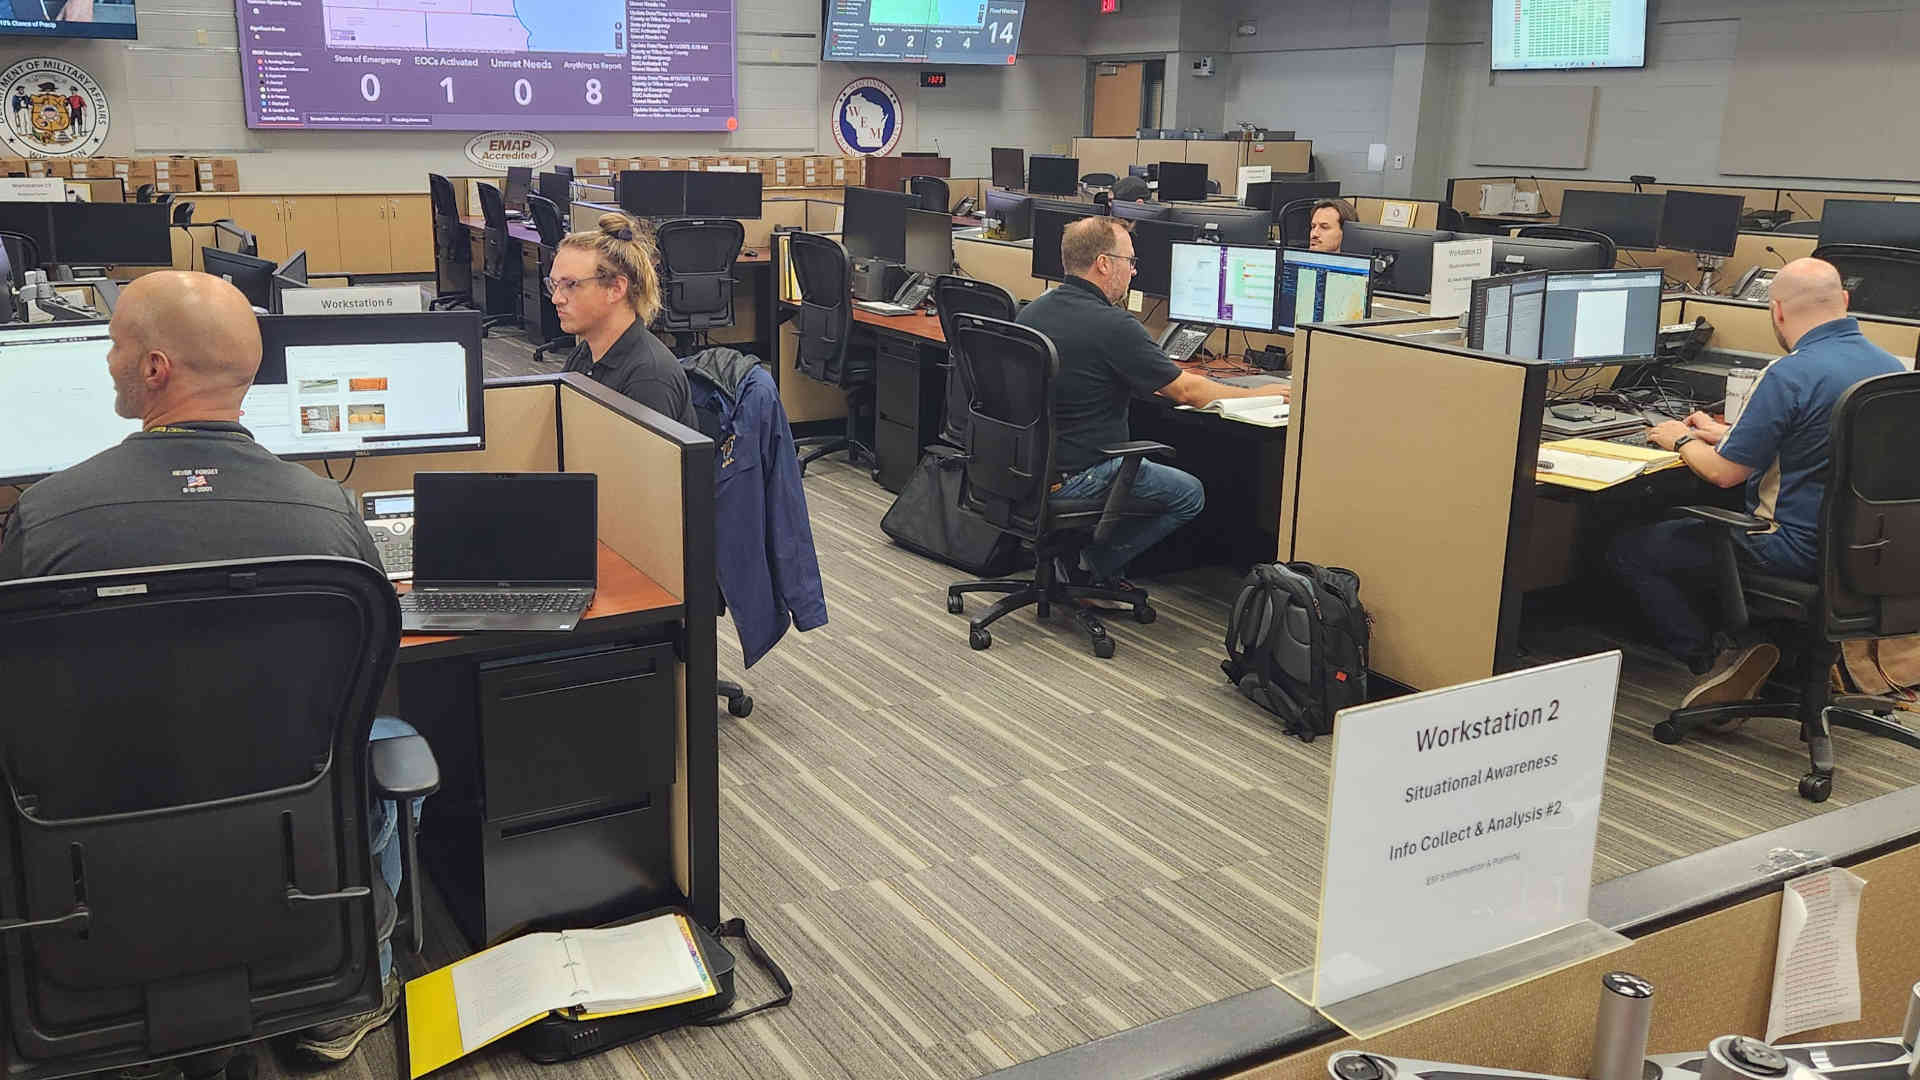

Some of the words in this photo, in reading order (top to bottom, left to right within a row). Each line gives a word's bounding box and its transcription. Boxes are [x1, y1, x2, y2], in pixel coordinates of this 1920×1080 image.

[989, 22, 1014, 44] 14
[878, 34, 886, 47] 0
[906, 35, 915, 48] 2
[935, 37, 944, 48] 3
[962, 37, 971, 49] 4
[334, 54, 353, 63] State
[354, 55, 362, 63] of
[363, 55, 401, 66] Emergency
[414, 56, 439, 66] EOCs
[440, 57, 479, 67] Activated
[490, 58, 521, 70] Unmet
[523, 59, 552, 70] Needs
[563, 61, 592, 71] Anything
[601, 61, 622, 71] Report
[26, 60, 41, 70] OF
[43, 60, 91, 86] MILITARY
[88, 85, 108, 125] AFFAIRS
[360, 73, 381, 102] 0
[439, 76, 455, 103] 1
[514, 78, 533, 106] 0
[585, 78, 603, 105] 8
[489, 140, 532, 152] EMAP
[482, 151, 537, 160] Accredited
[321, 298, 385, 309] Workstation
[386, 297, 393, 306] 6
[1416, 706, 1543, 752] Workstation
[1547, 699, 1560, 722] 2
[1404, 768, 1482, 804] Situational
[1485, 753, 1559, 784] Awareness
[1389, 840, 1418, 861] Info
[1421, 824, 1472, 852] Collect
[1474, 821, 1484, 837] &
[1487, 806, 1543, 833] Analysis
[1545, 800, 1562, 818] #2
